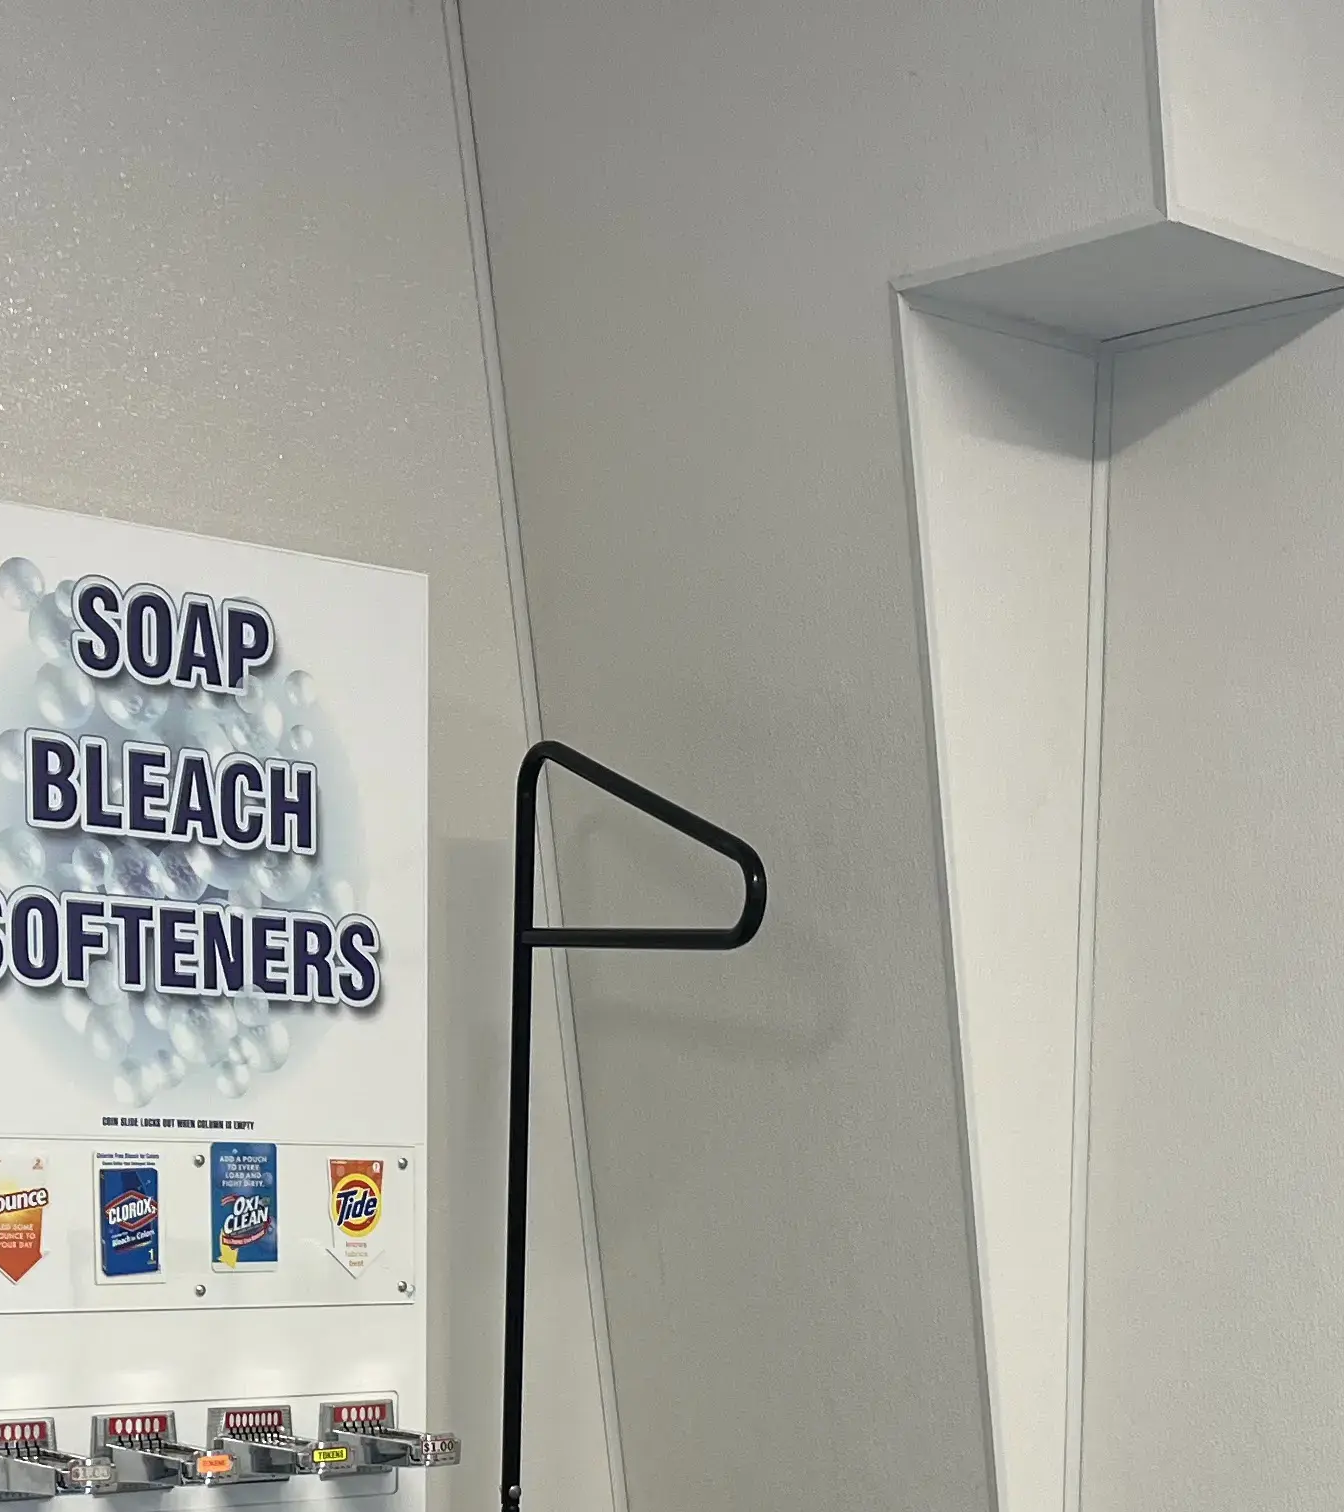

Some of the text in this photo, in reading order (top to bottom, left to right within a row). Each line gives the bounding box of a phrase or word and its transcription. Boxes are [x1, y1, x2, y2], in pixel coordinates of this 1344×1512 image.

[74, 580, 273, 692] SOAP
[28, 733, 315, 852] BLEACH
[140, 1118, 160, 1127] LOCKS
[162, 1118, 175, 1128] OUT
[176, 1119, 195, 1128] WHEN
[197, 1120, 224, 1129] COLUMN
[225, 1120, 232, 1129] IS
[233, 1120, 254, 1130] EMPTY
[242, 1155, 267, 1163] POUCH
[225, 1171, 262, 1179] LOAD AND
[221, 1179, 242, 1187] FIGHT
[108, 1197, 152, 1225] CLOROX
[233, 1195, 259, 1216] OXI
[336, 1189, 378, 1227] Tide
[223, 1206, 268, 1235] CLEAN
[26, 1232, 36, 1240] TO
[18, 1241, 33, 1249] DAY
[423, 1440, 454, 1452] $1.00
